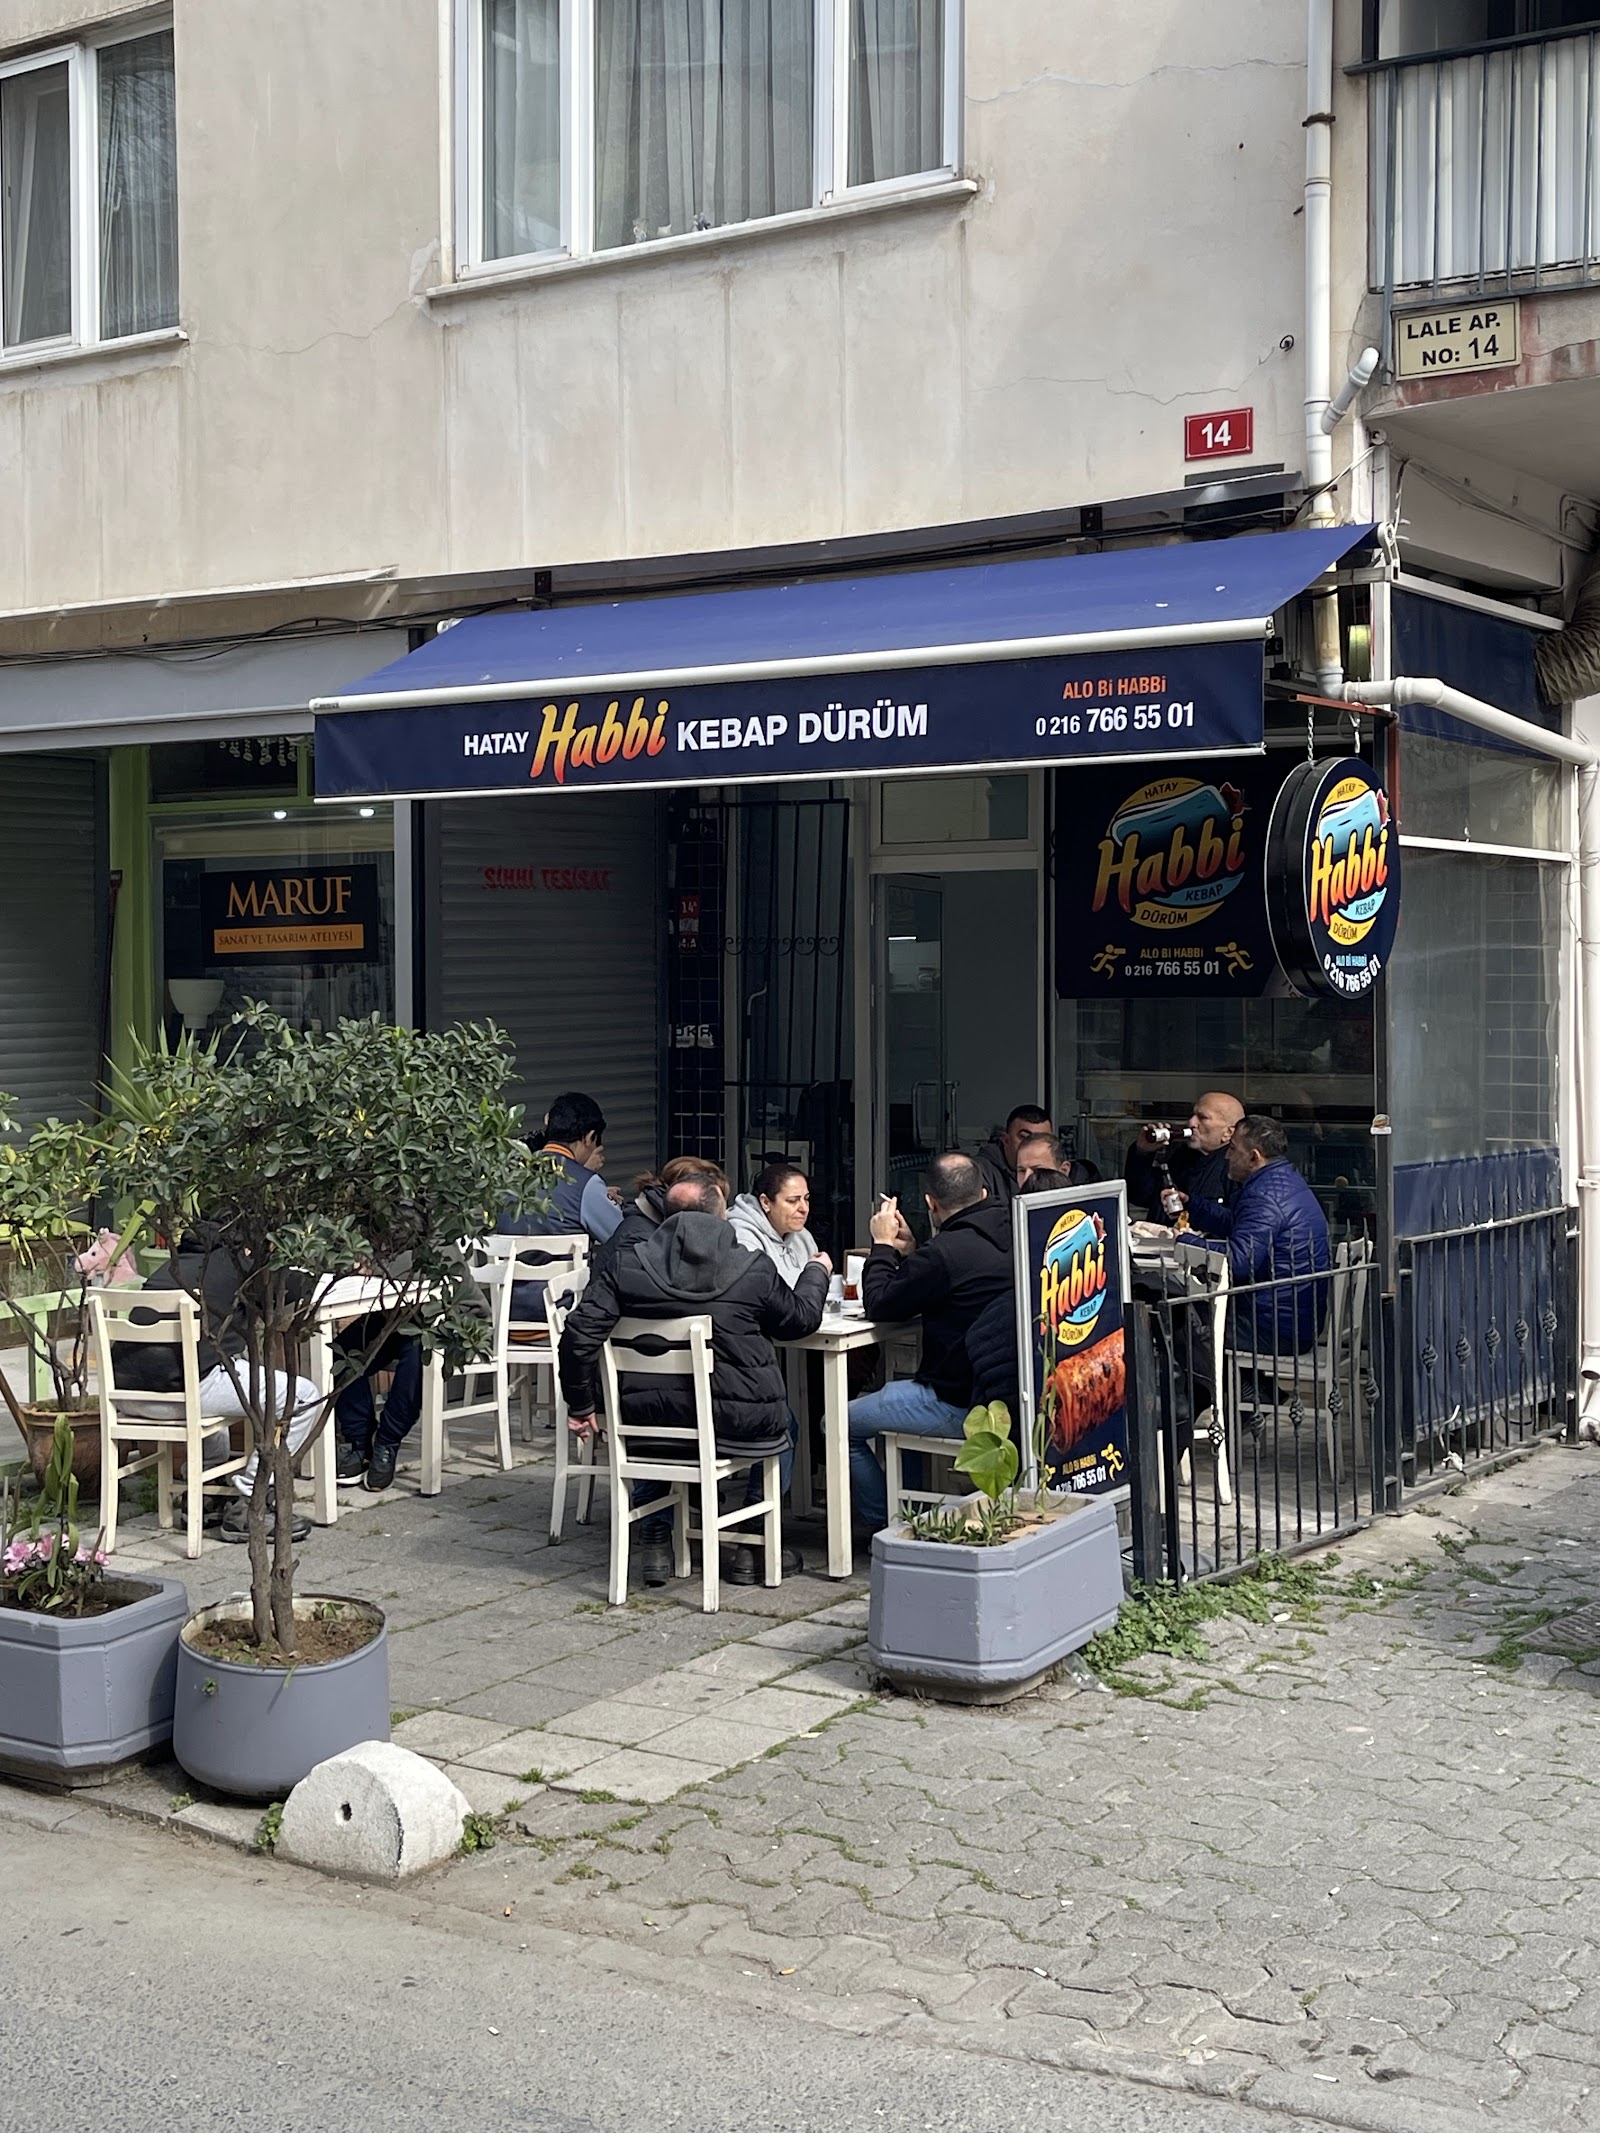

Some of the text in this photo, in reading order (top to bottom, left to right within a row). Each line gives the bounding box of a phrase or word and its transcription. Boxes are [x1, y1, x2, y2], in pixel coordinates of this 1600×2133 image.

[1407, 312, 1500, 339] LALE AP.
[1422, 334, 1499, 366] NO: 14
[1201, 420, 1232, 448] 14
[1063, 680, 1093, 699] ALO
[1035, 702, 1194, 736] 0 216 766 55 01
[464, 696, 928, 784] HATAY Habbi KEBAP DÜRÜM
[1144, 782, 1178, 800] HATAY
[1337, 783, 1356, 798] HATAY
[1091, 817, 1245, 913] Habbi
[1310, 825, 1388, 925] Habbi
[226, 876, 352, 918] MARUF
[1185, 883, 1224, 901] KEBAP
[1355, 899, 1375, 915] KEBAP
[219, 934, 248, 946] SANAT
[251, 934, 263, 944] VE
[266, 932, 308, 943] TASARIM
[1140, 948, 1159, 959] ALO
[1125, 961, 1219, 976] 0 216 766 55 01
[1324, 953, 1381, 992] 0 216 766 55 01
[1040, 1242, 1106, 1335] Habbi
[1072, 1472, 1086, 1491] 766
[1086, 1469, 1097, 1486] 55
[1096, 1465, 1106, 1482] 01
